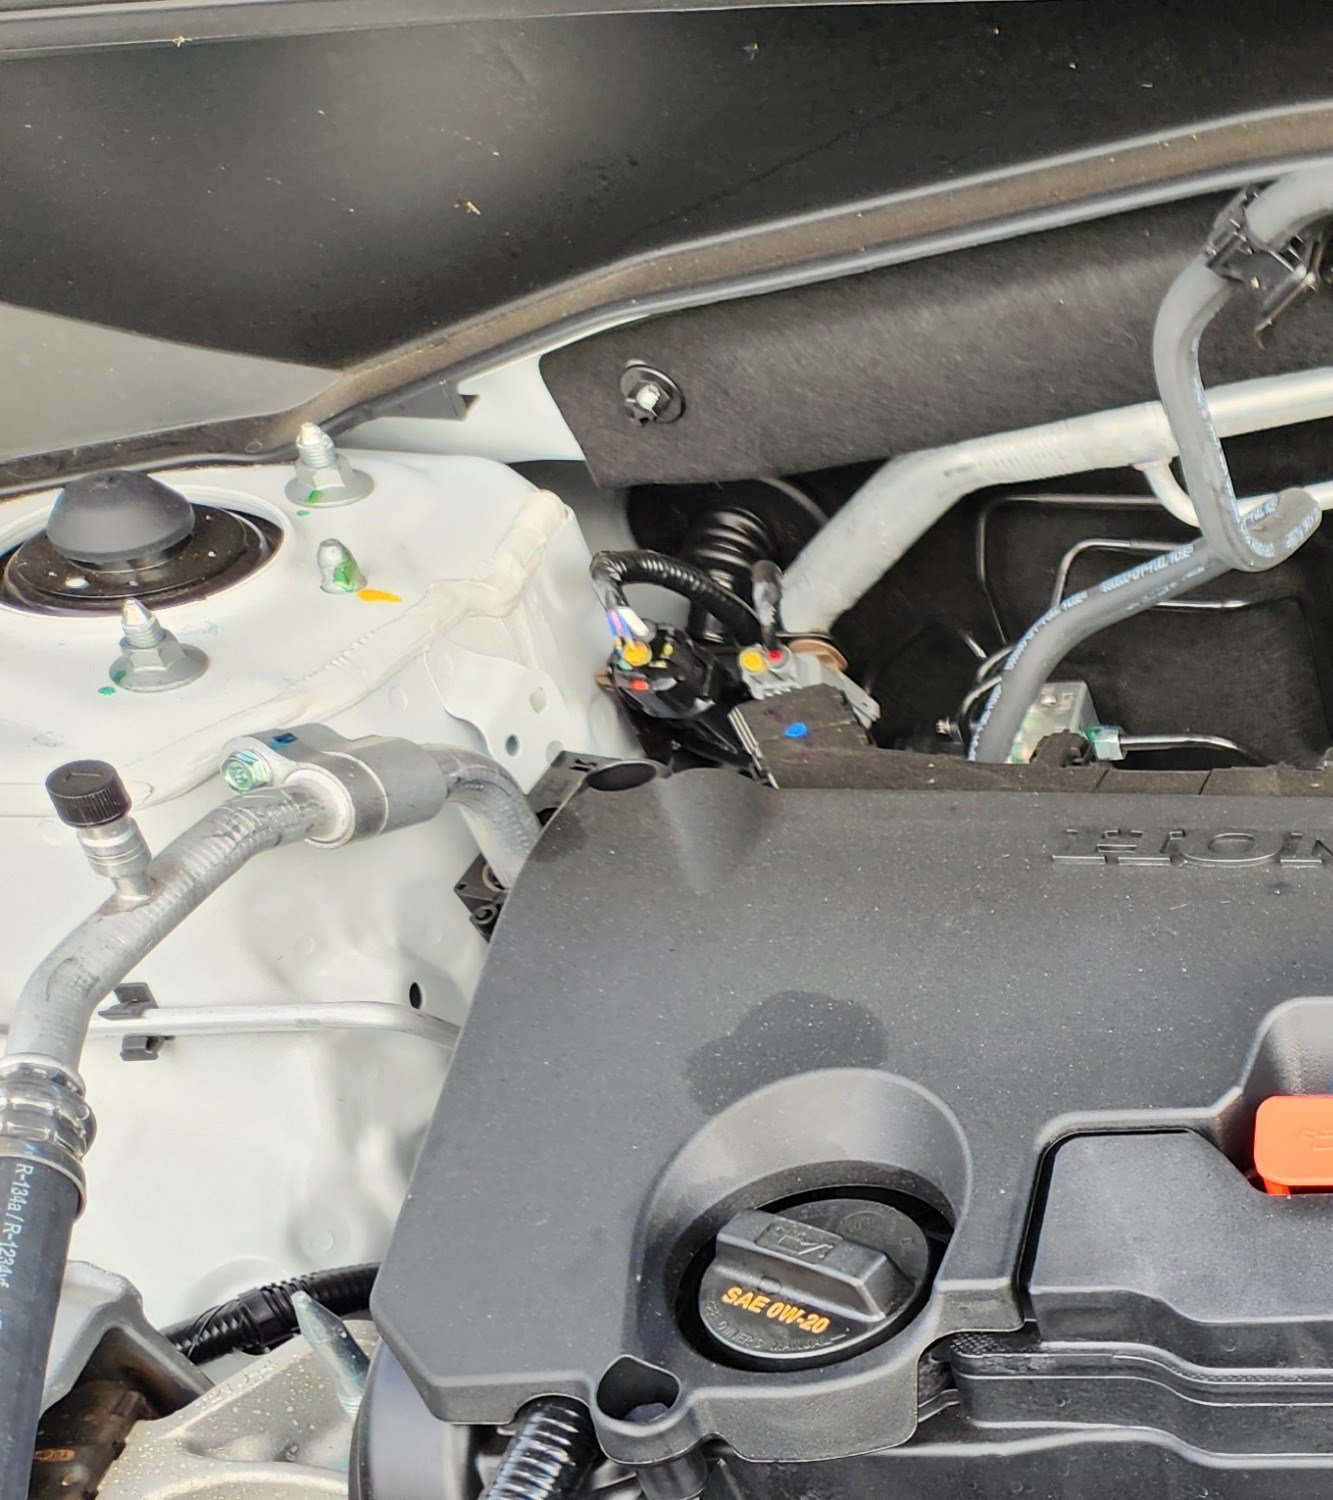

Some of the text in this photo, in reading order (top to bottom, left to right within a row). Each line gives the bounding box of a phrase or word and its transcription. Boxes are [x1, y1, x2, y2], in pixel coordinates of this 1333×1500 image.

[7, 1163, 34, 1211] R-134a
[721, 1286, 831, 1334] SAE 0W-20
